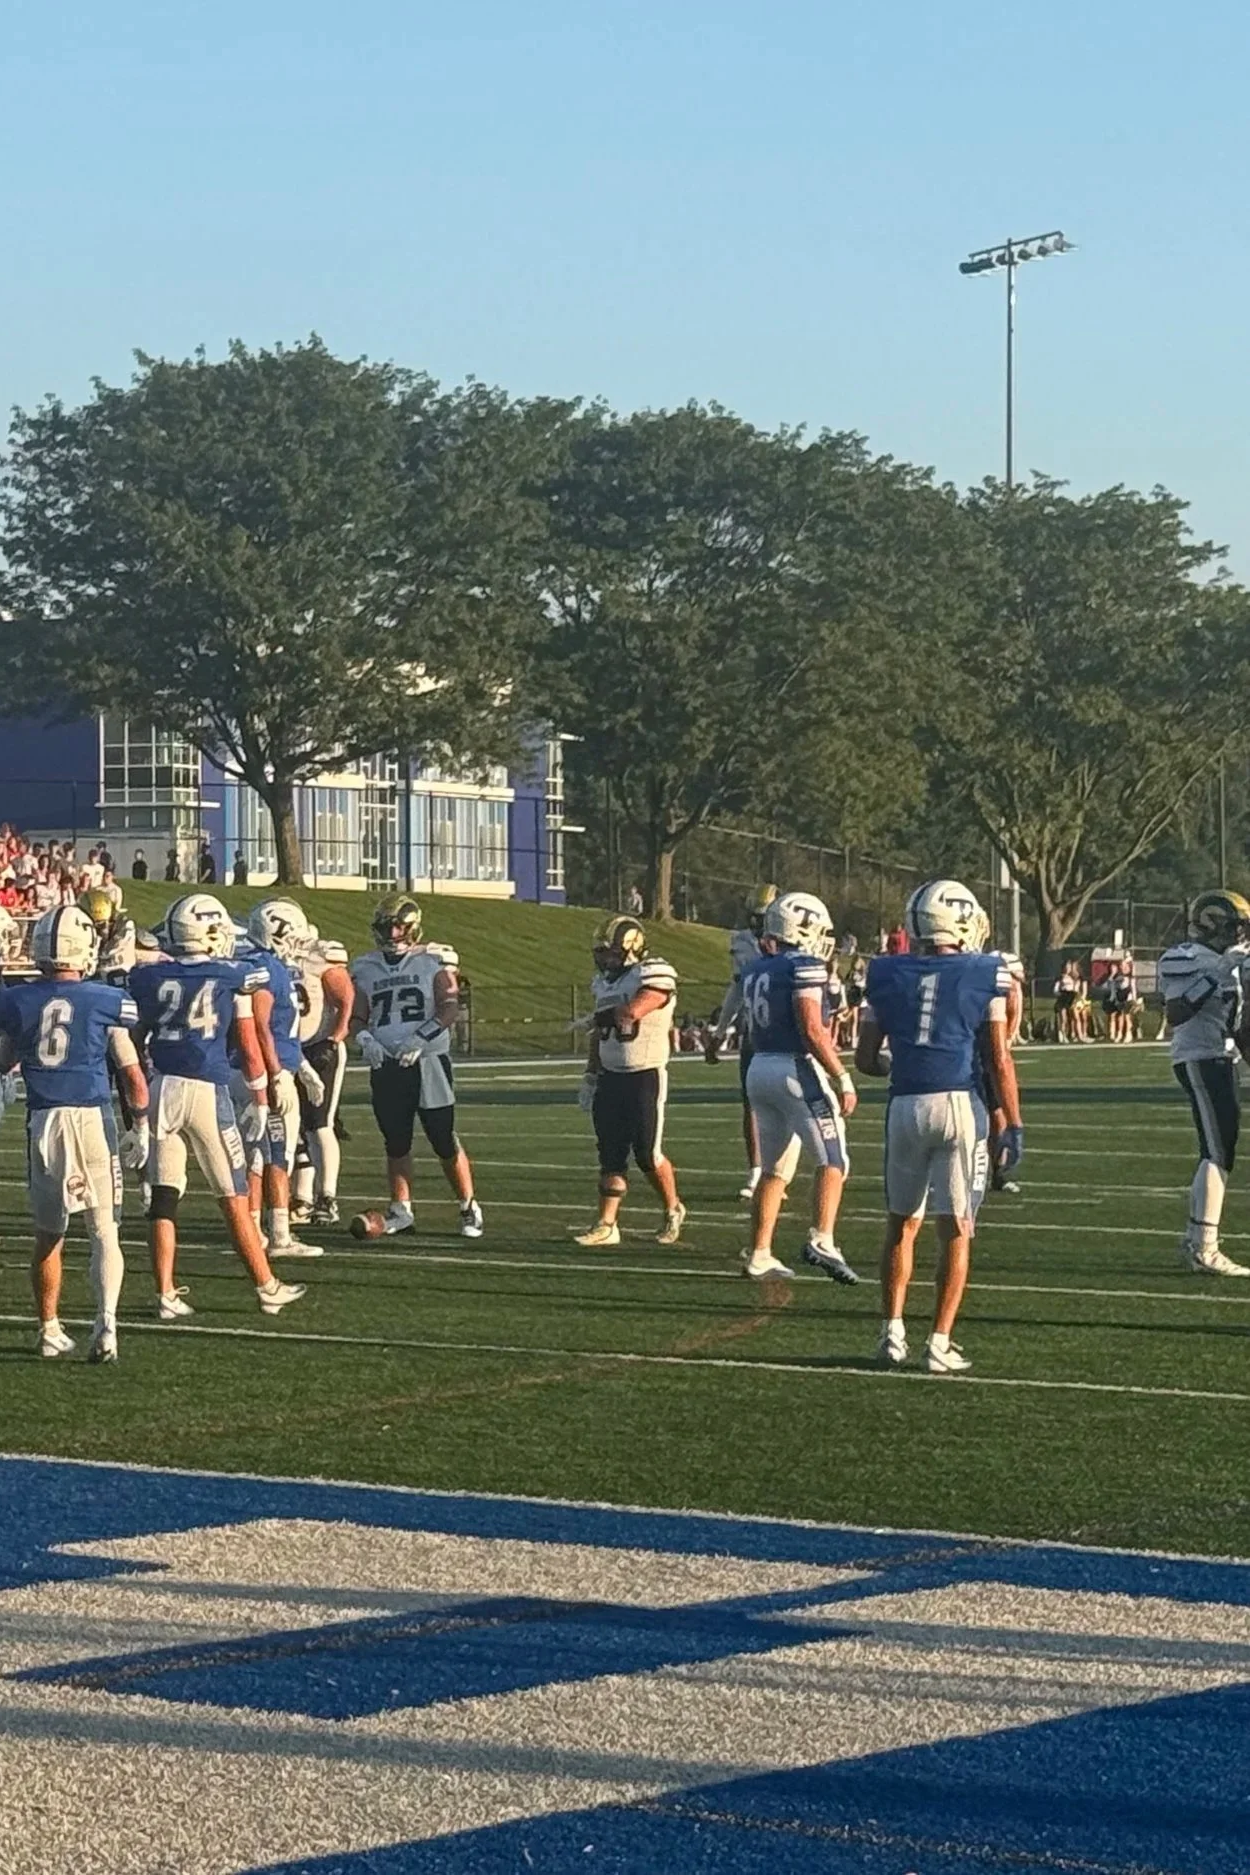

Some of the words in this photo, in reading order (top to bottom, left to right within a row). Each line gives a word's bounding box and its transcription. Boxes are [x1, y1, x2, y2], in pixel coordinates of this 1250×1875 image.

[37, 996, 75, 1068] 6
[158, 978, 220, 1041] 24
[371, 986, 426, 1028] 72
[915, 972, 941, 1047] 1
